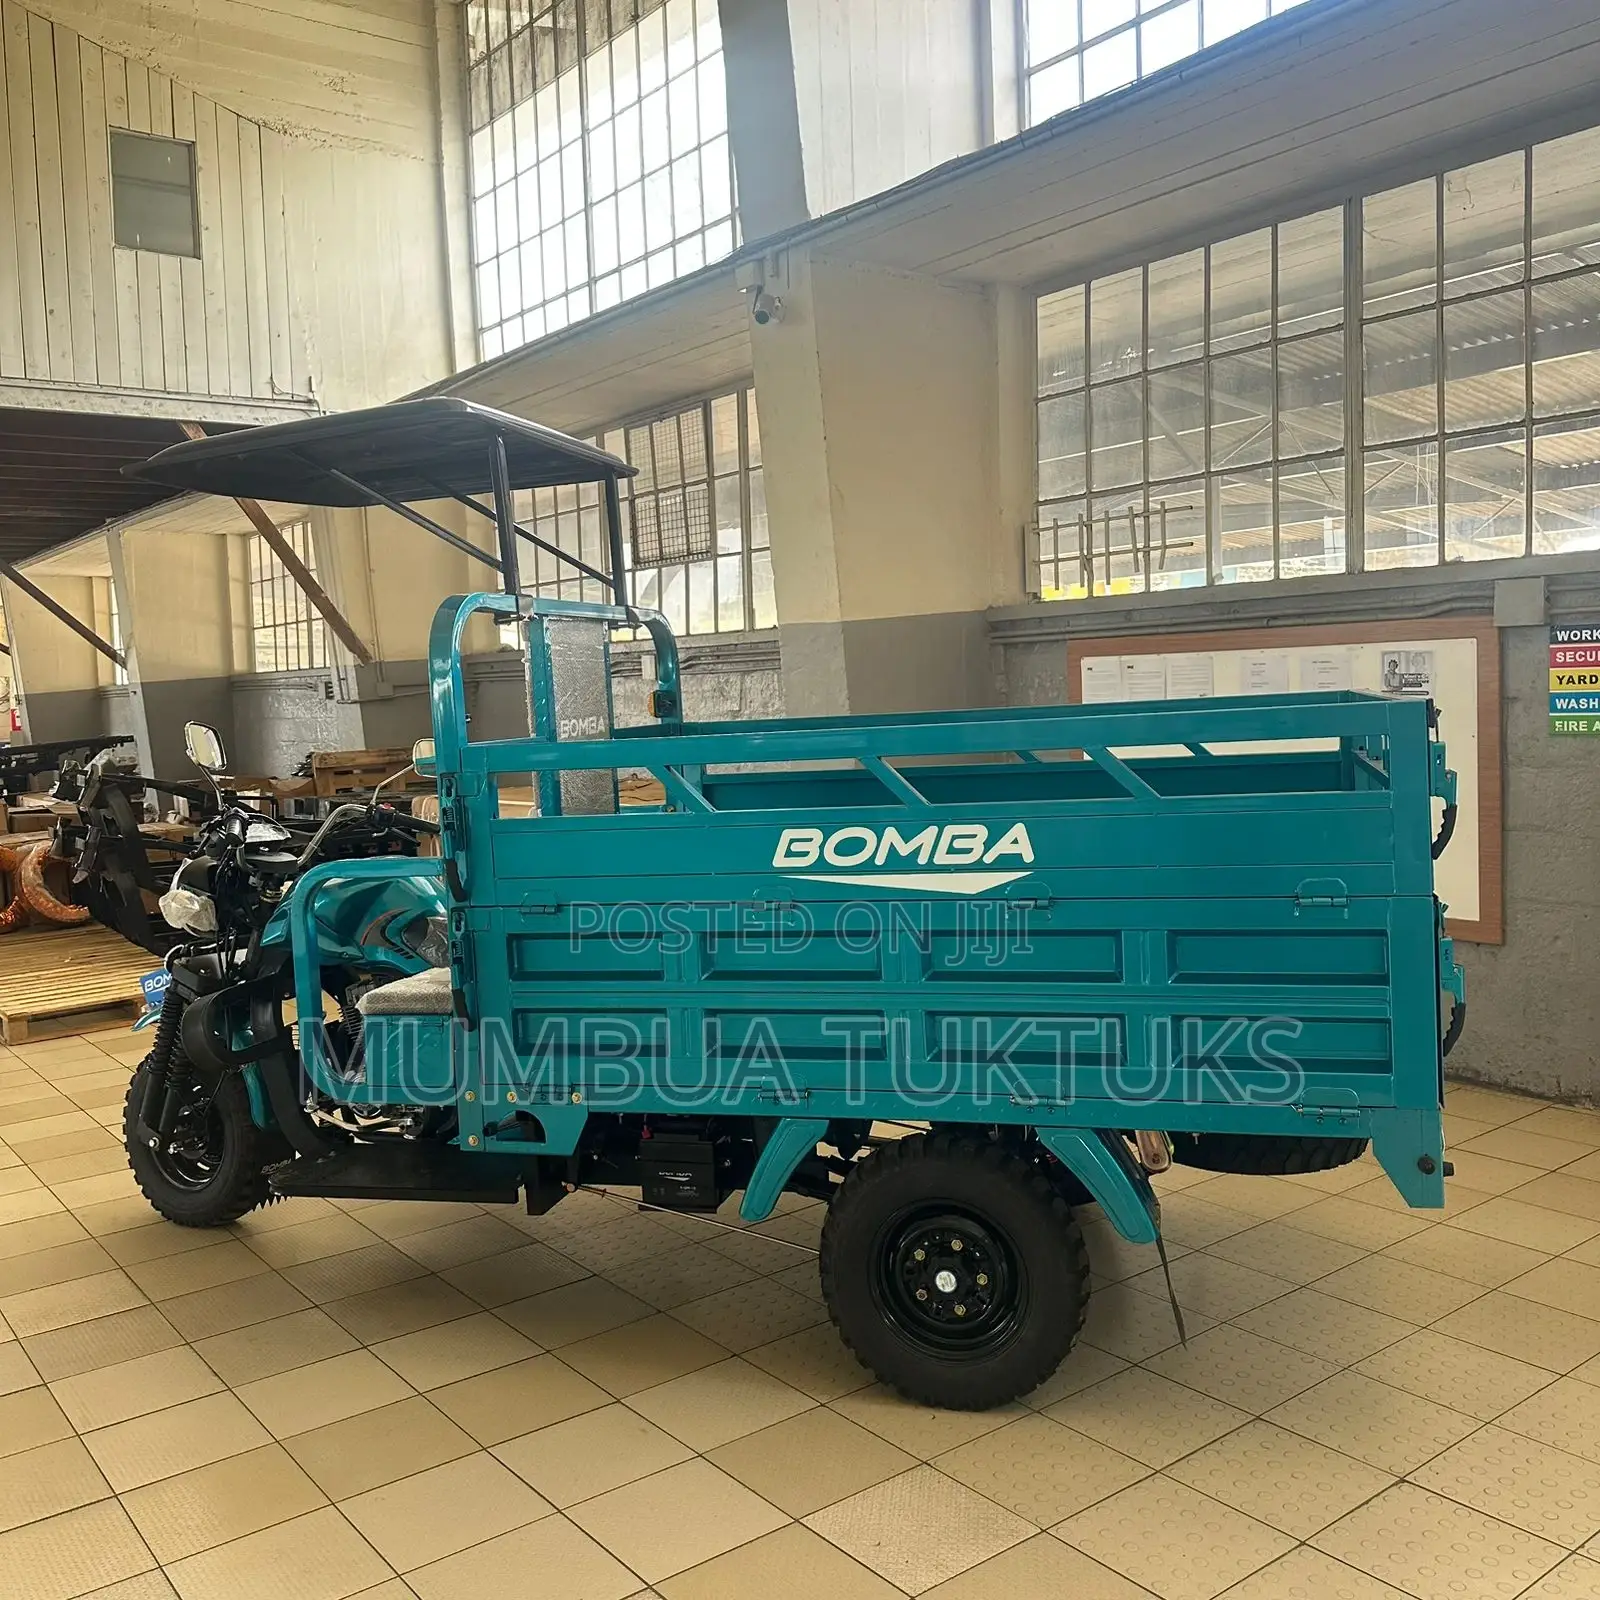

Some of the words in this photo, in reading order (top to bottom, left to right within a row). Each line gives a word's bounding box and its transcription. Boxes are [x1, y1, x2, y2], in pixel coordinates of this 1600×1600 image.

[1555, 651, 1600, 662] SECU
[1556, 675, 1599, 685] YARD
[1555, 698, 1599, 709] WASH
[560, 716, 605, 738] BOMBA
[1555, 721, 1588, 731] FIRE
[772, 822, 1035, 868] BOMBA
